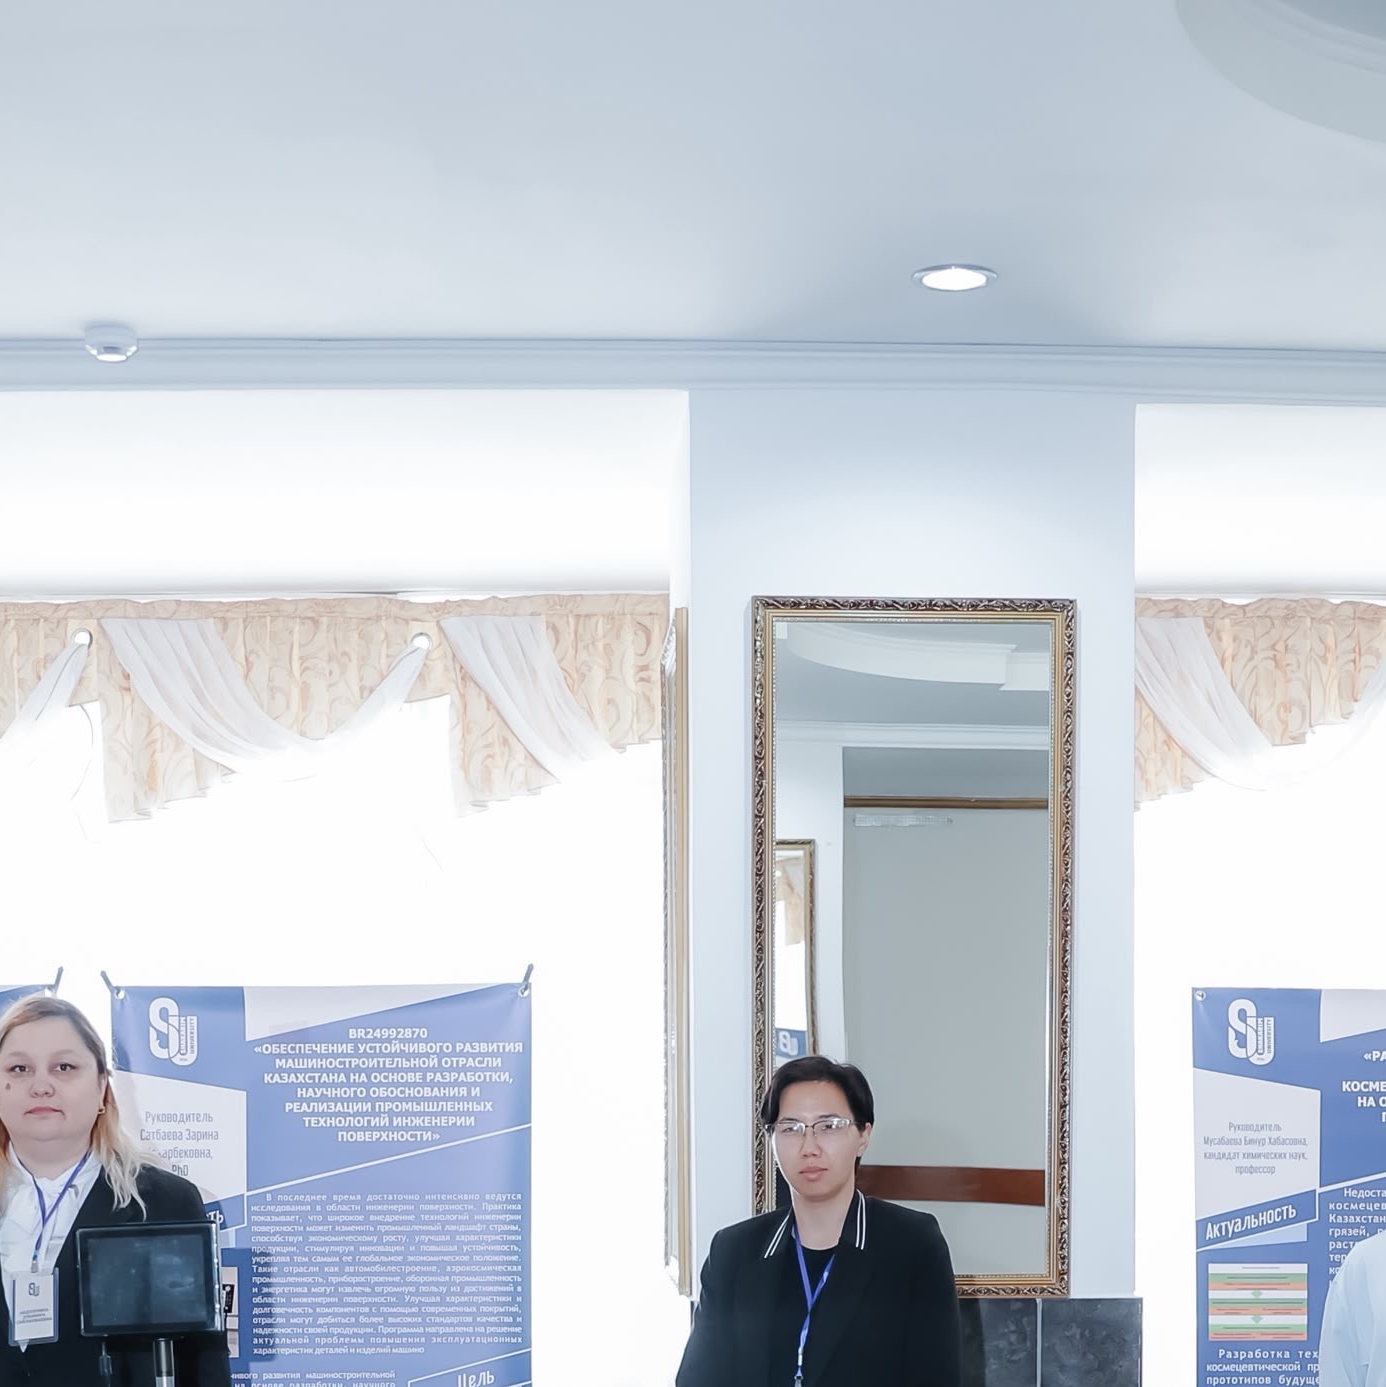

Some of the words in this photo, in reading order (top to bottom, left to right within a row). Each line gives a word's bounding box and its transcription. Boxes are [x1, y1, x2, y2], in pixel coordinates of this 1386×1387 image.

[348, 1027, 427, 1039] BR24992870
[253, 1043, 354, 1054] «ОБЕСПЕЧЕНИЕ
[357, 1039, 452, 1053] УСТОЙЧИВОГО
[455, 1041, 522, 1053] РАЗВИТИЯ
[275, 1054, 438, 1068] МАШИНОСТРОИТЕЛЬНОЙ
[441, 1056, 501, 1067] ОТРАСЛИ
[264, 1072, 347, 1083] КАЗАХСТАНА
[349, 1072, 368, 1083] НА
[370, 1072, 423, 1083] ОСНОВЕ
[426, 1071, 513, 1084] РАЗРАБОТКИ,
[297, 1086, 366, 1098] НАУЧНОГО
[369, 1086, 467, 1097] ОБОСНОВАНИЯ
[471, 1086, 480, 1097] И
[285, 1101, 371, 1114] РЕАЛИЗАЦИИ
[375, 1101, 493, 1112] ПРОМЫШЛЕННЫХ
[1357, 1095, 1376, 1107] НА
[302, 1113, 389, 1127] ТЕХНОЛОГИЙ
[392, 1115, 474, 1127] ИНЖЕНЕРИИ
[337, 1130, 440, 1142] ПОВЕРХНОСТИ»
[1205, 1204, 1296, 1240] Актуальность
